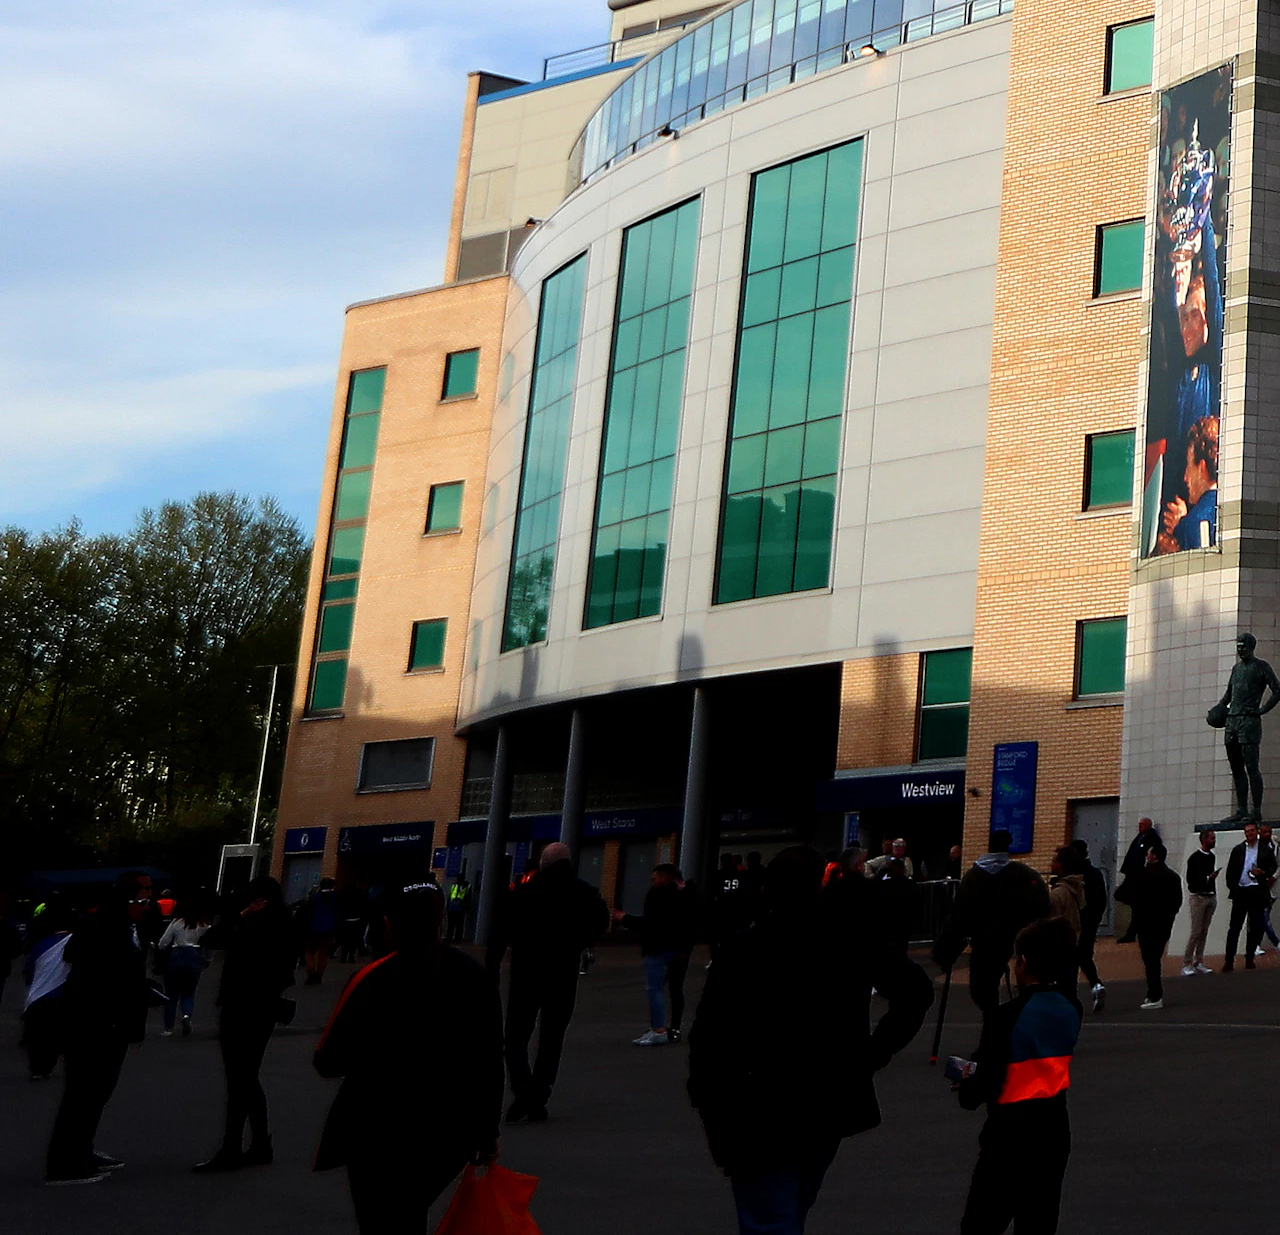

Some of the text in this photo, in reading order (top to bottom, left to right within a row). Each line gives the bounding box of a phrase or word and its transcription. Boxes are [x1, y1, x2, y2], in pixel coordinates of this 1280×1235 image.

[901, 781, 956, 798] Westview
[591, 817, 637, 830] West Stand
[724, 879, 740, 892] 39
